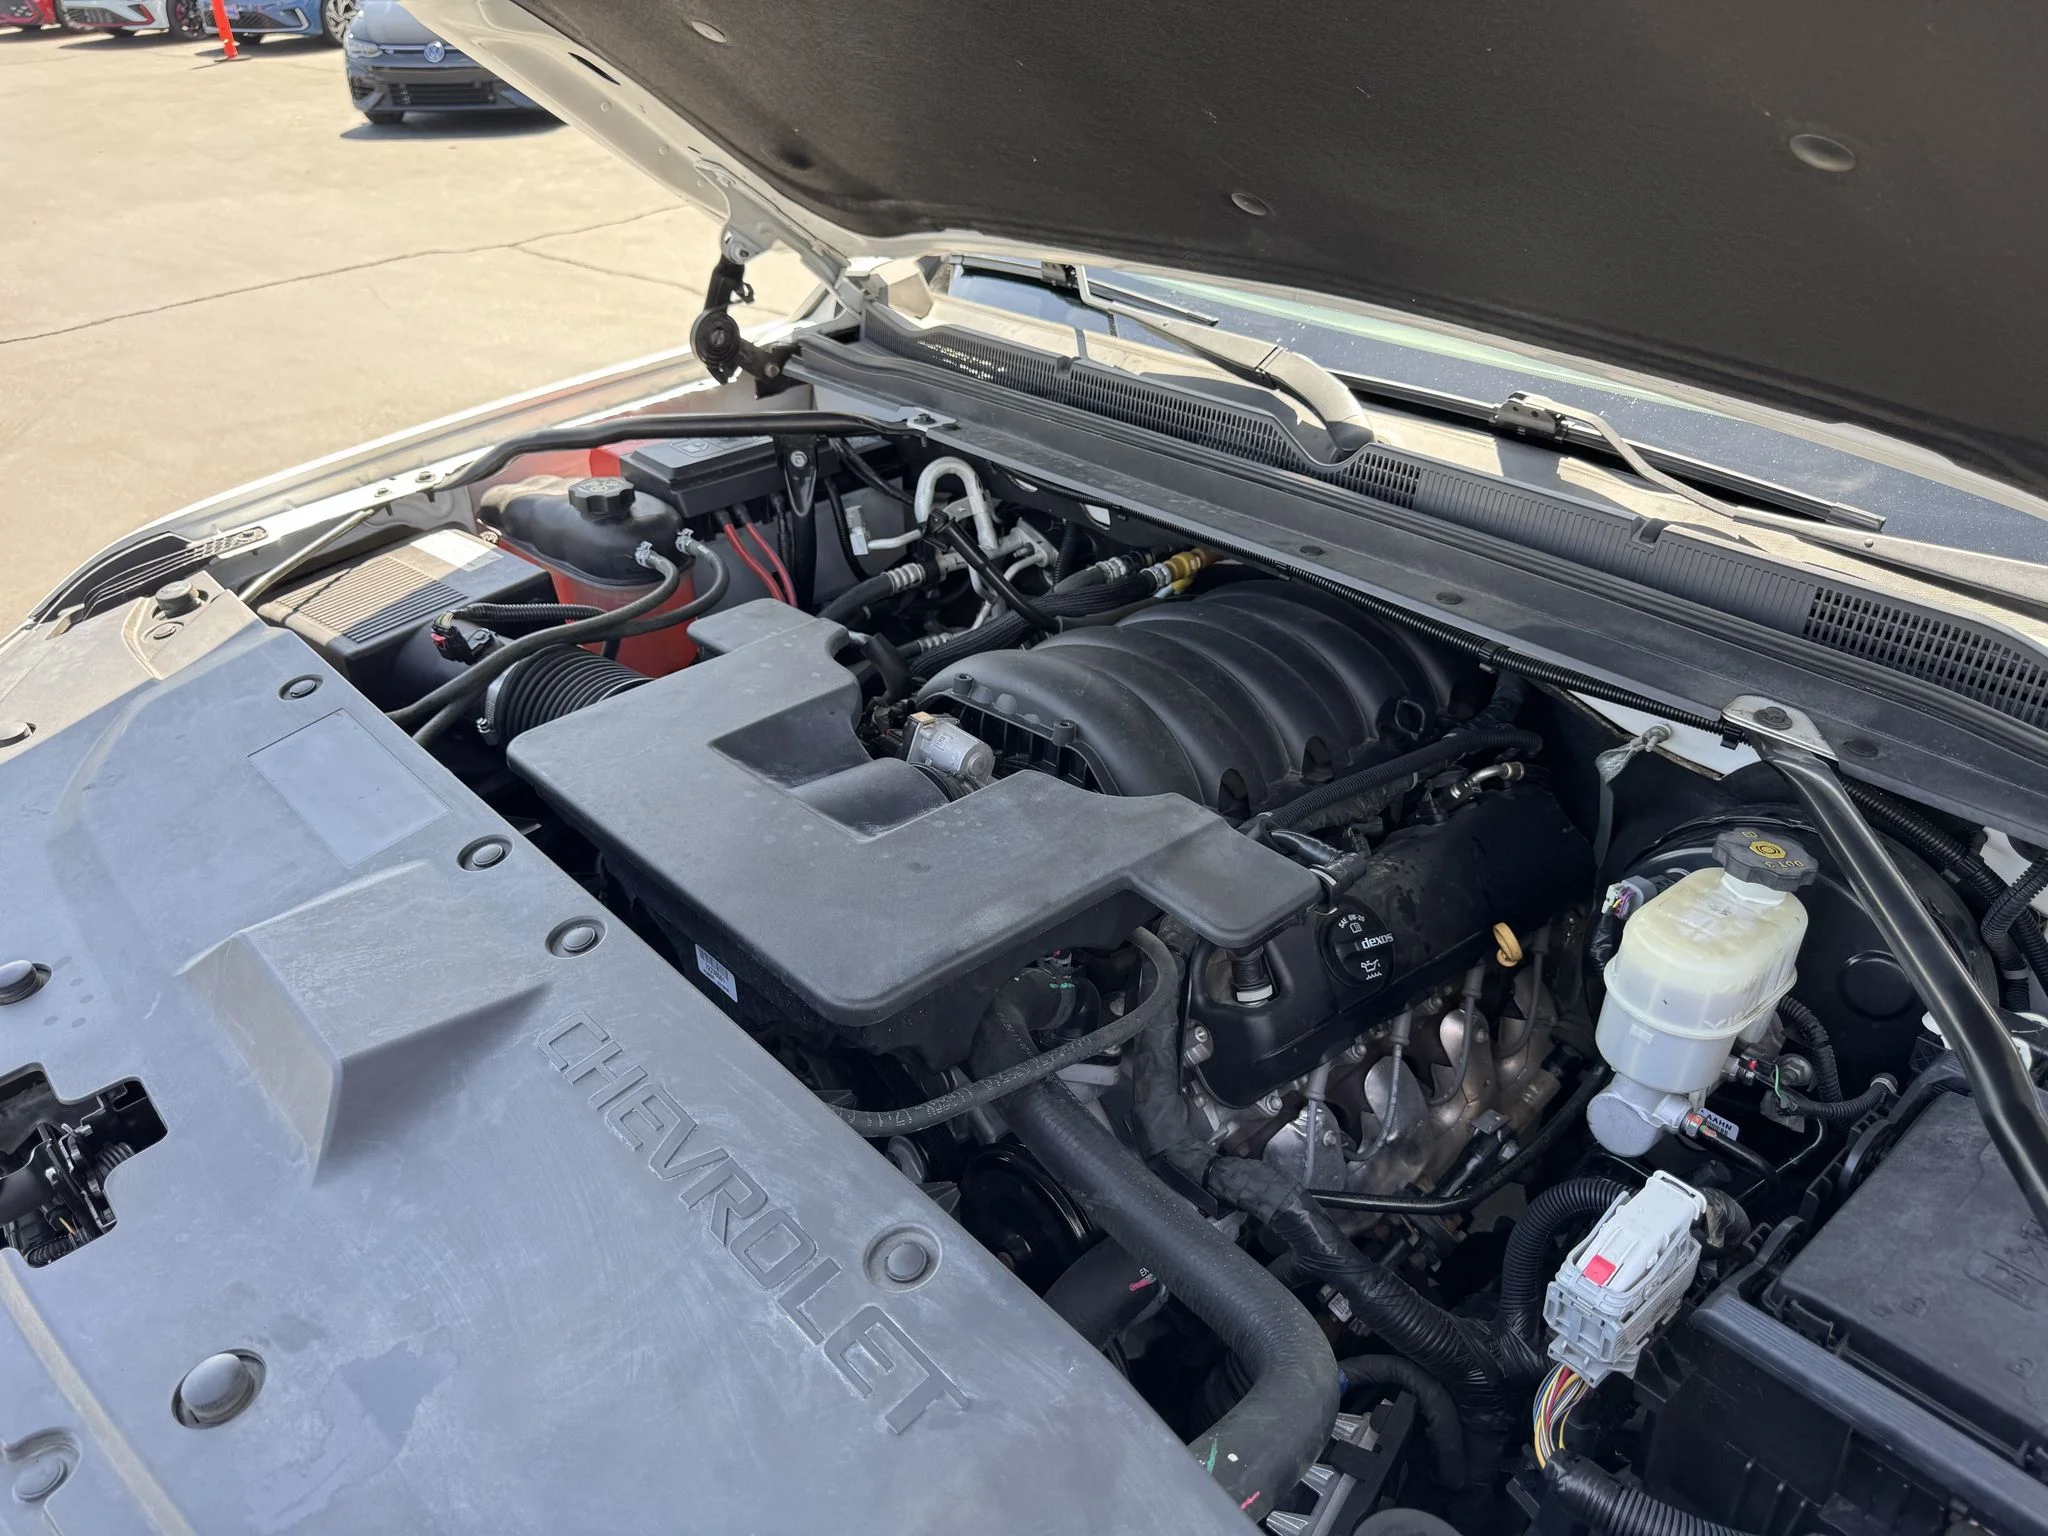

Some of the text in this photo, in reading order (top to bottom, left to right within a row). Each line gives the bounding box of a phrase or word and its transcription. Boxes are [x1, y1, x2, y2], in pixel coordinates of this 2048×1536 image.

[1778, 860, 1805, 869] DOT
[1338, 917, 1348, 928] SAE
[1361, 933, 1394, 949] dexos
[1706, 1114, 1733, 1131] AAHN
[536, 1010, 970, 1436] CHEVROLET
